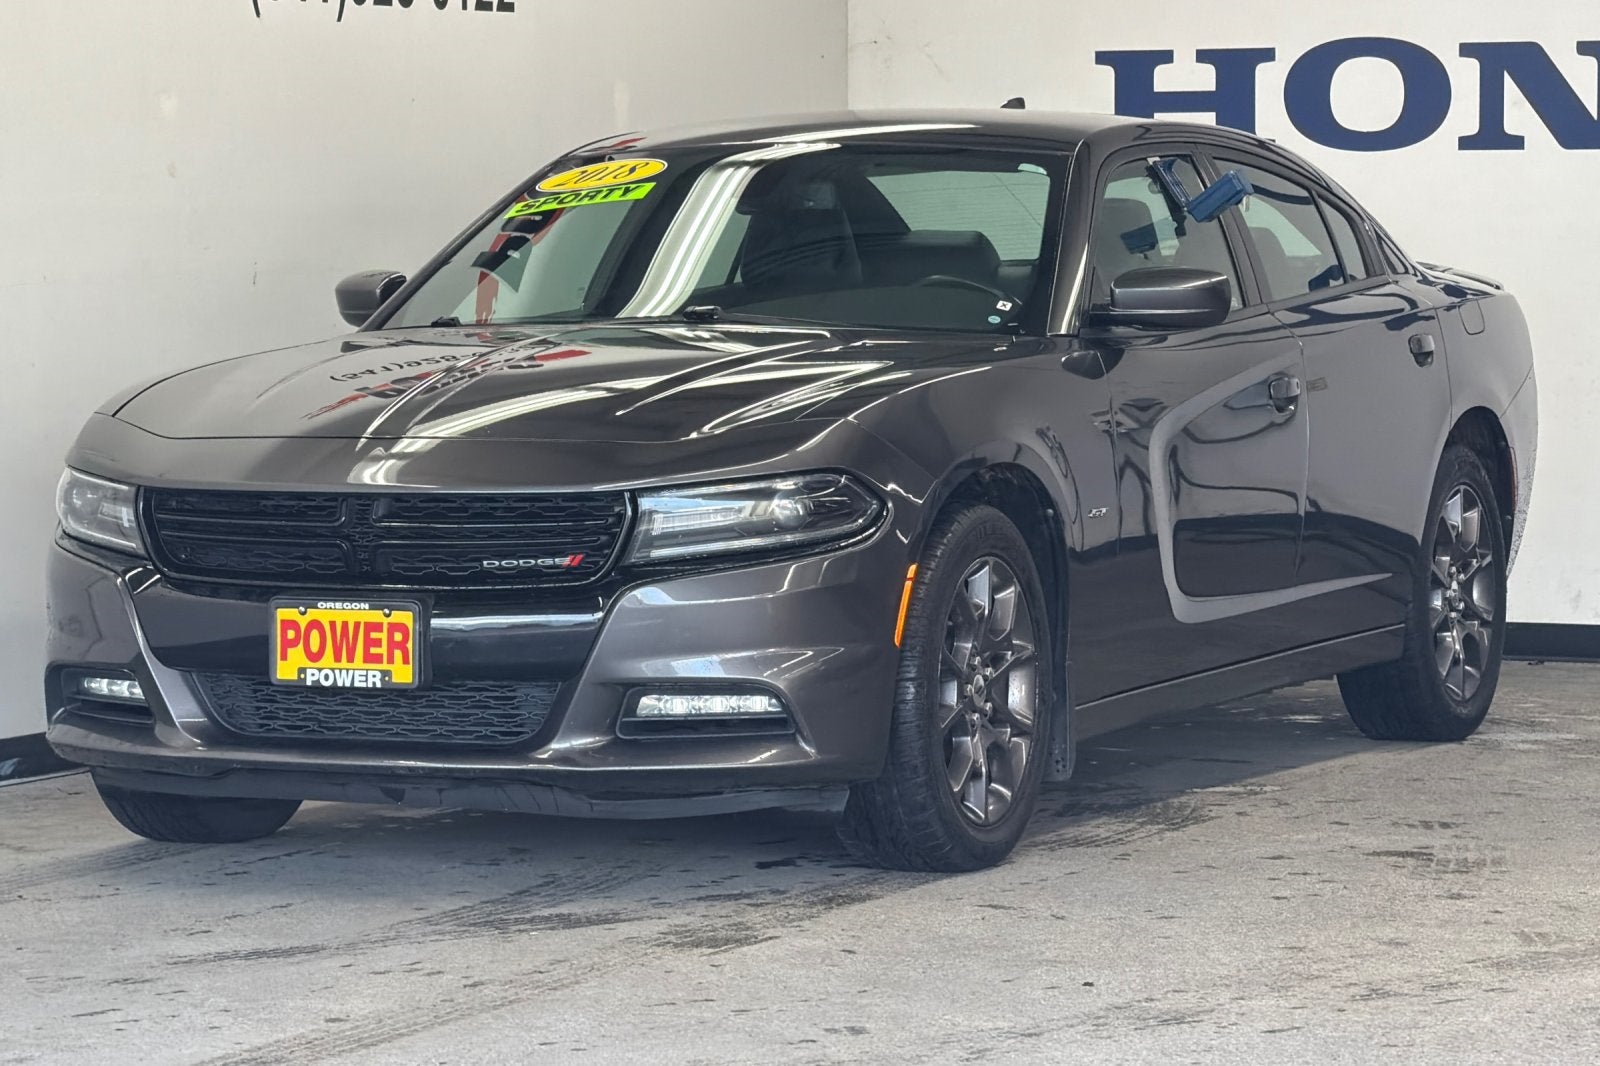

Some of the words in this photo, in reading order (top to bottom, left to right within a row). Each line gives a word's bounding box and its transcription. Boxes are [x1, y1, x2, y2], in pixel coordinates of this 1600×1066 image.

[515, 185, 641, 213] SPORTY
[482, 558, 571, 568] DODGE
[317, 601, 369, 610] OREGON
[280, 618, 410, 665] POWER
[306, 668, 382, 688] POWER
